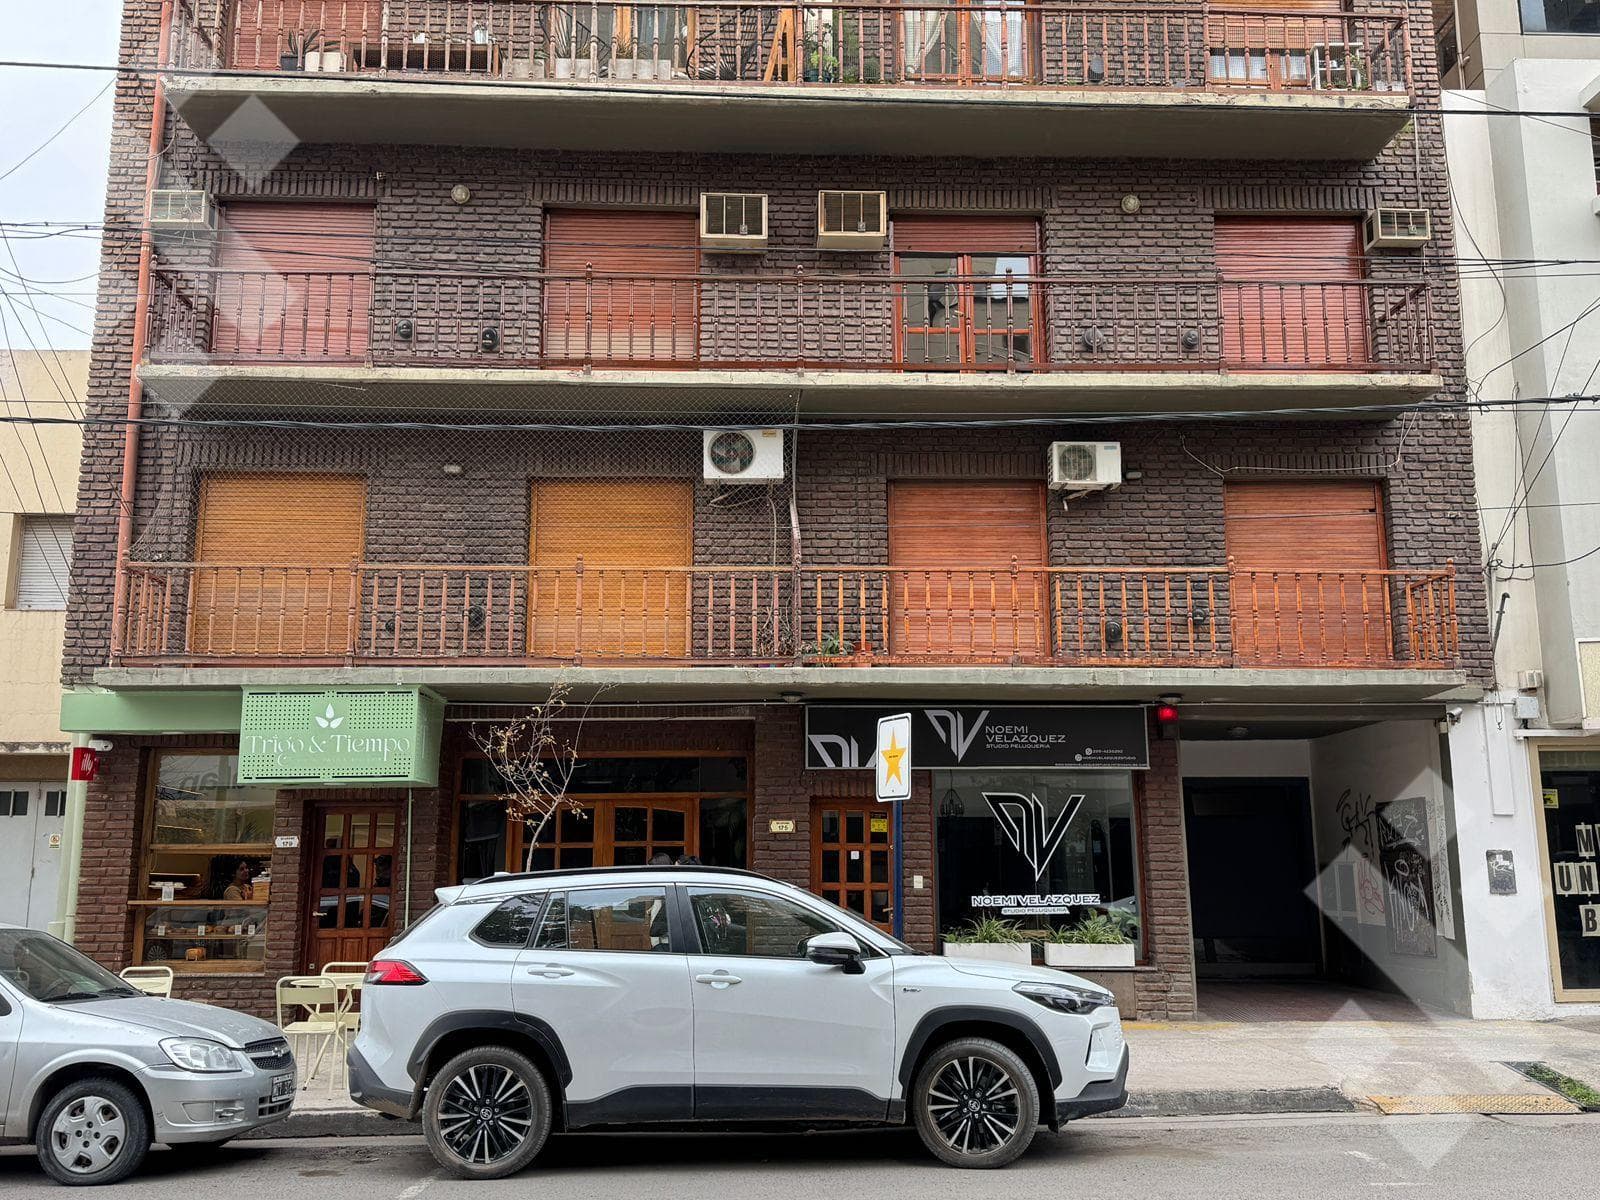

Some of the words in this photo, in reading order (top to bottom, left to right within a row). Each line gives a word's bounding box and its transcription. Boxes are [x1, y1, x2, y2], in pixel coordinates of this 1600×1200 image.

[985, 725, 1028, 734] NOEMI
[985, 734, 1066, 743] VELAZQUEZ
[245, 734, 305, 767] Trigo
[309, 735, 327, 754] &
[330, 733, 411, 762] Tiempo
[1558, 864, 1593, 892] UN
[971, 895, 1017, 907] NOEMI
[1017, 894, 1100, 906] VELAZQUEZ
